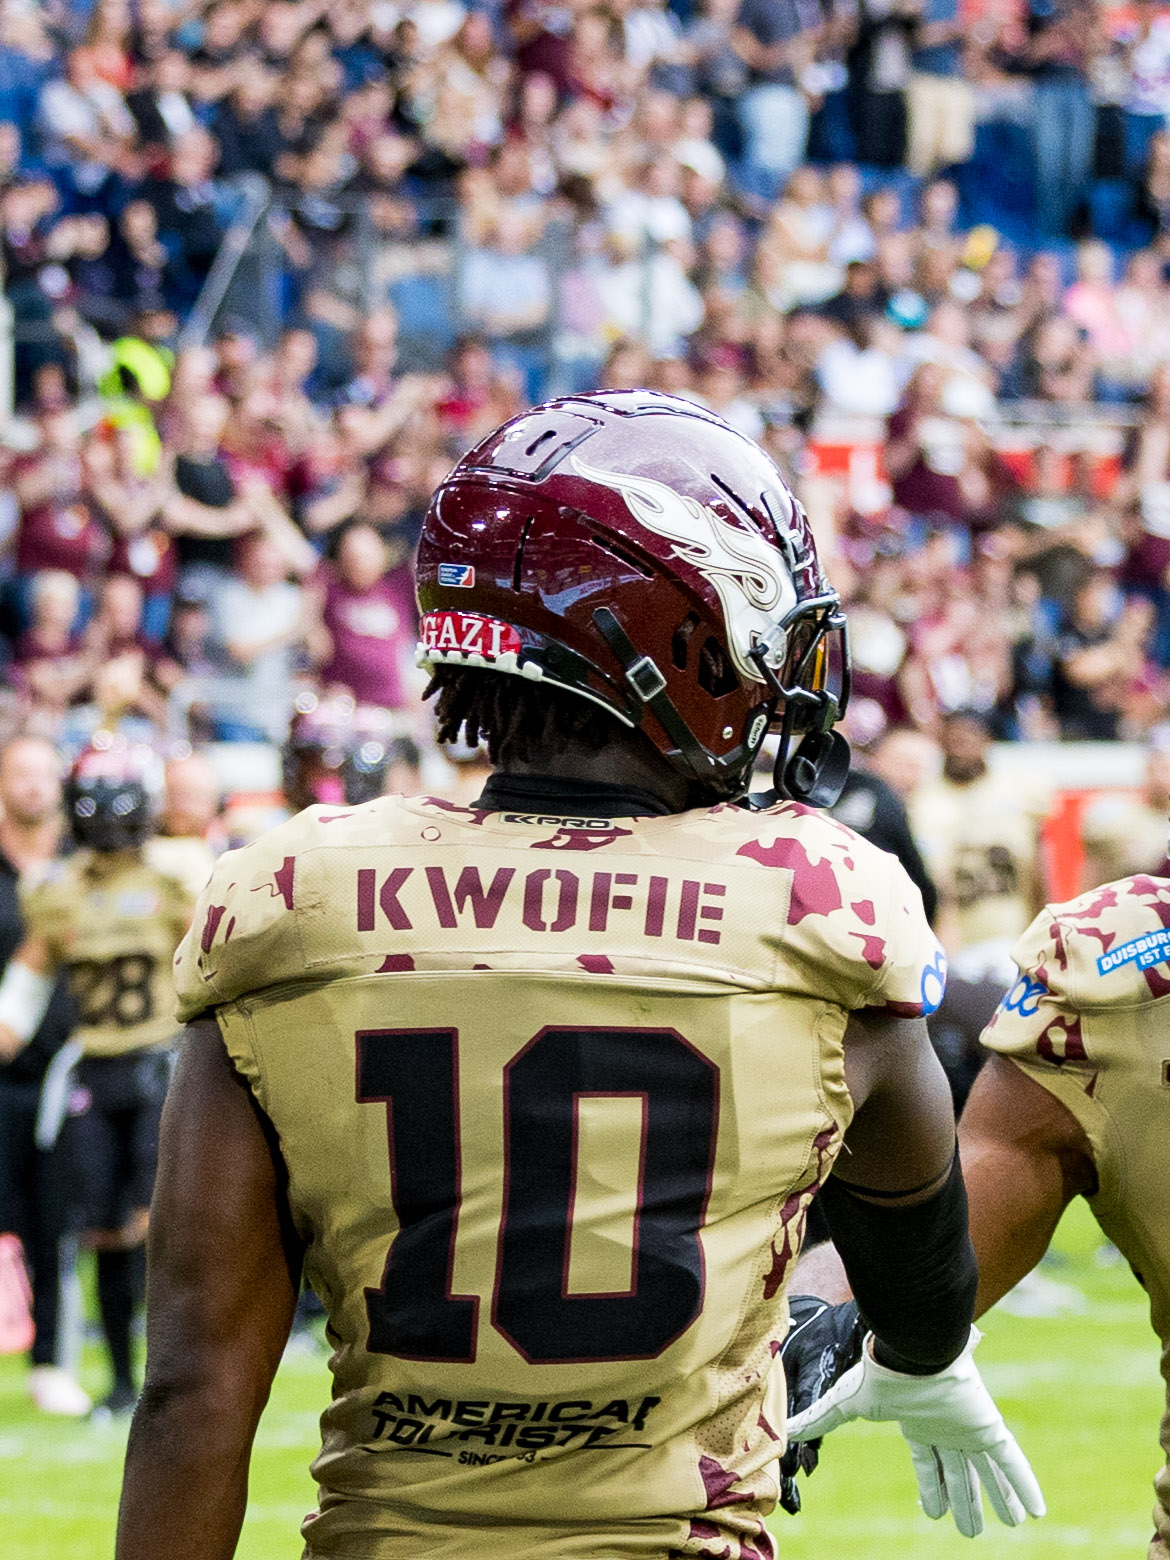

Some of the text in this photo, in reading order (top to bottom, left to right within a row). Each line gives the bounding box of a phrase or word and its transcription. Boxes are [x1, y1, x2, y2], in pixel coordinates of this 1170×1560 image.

[422, 615, 505, 657] GAZI
[357, 866, 727, 945] KWOFIE
[67, 953, 155, 1027] 28
[1139, 948, 1160, 966] IST
[355, 1025, 721, 1366] 10
